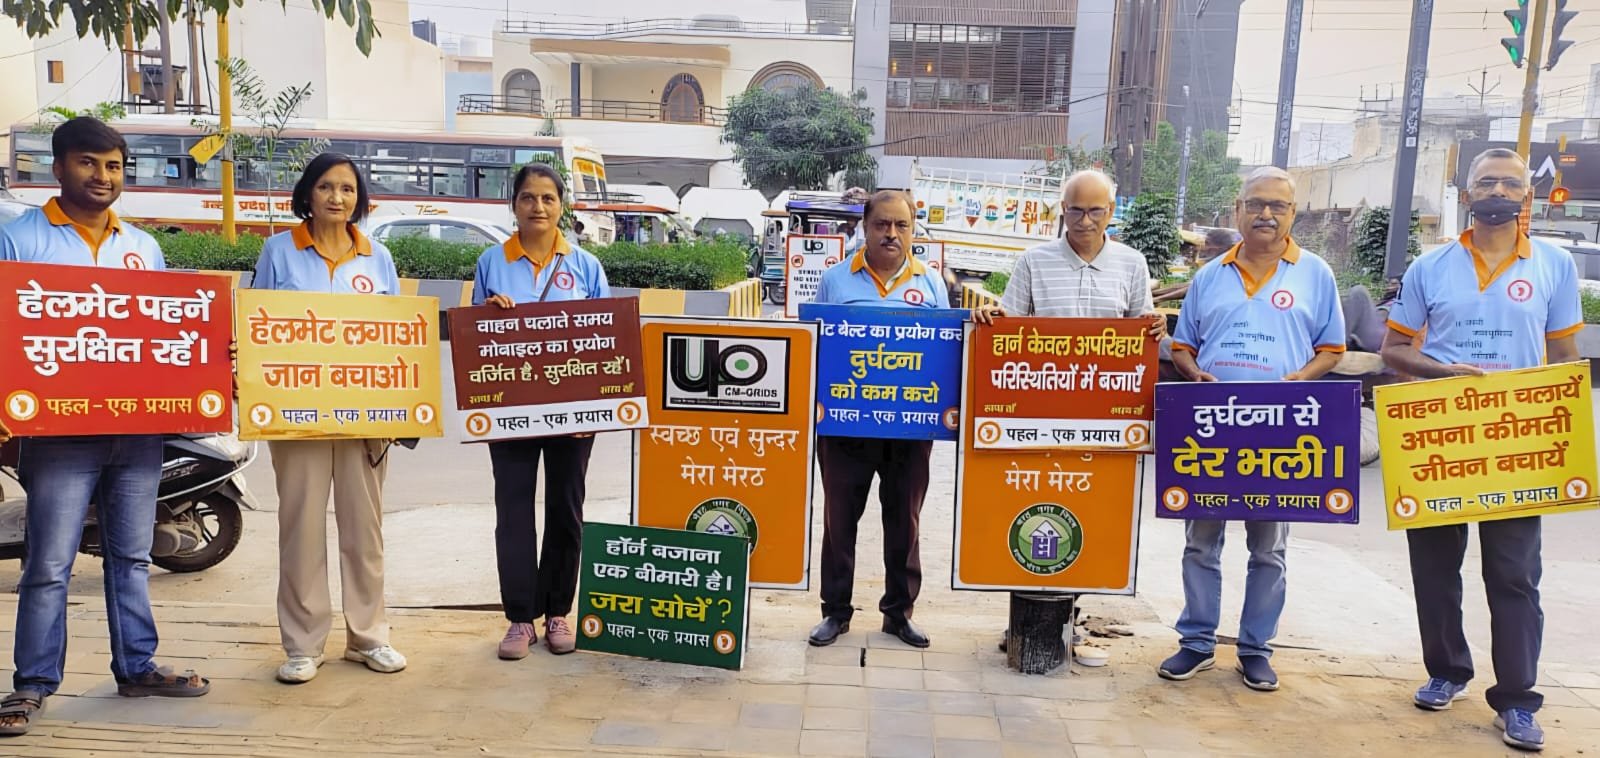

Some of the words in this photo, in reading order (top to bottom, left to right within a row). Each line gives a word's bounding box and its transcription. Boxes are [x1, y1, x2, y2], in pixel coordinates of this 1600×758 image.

[16, 279, 131, 319] हेलमेट
[136, 289, 216, 323] पहनें
[249, 306, 336, 345] हेलमेट
[341, 313, 428, 346] लगाओ
[476, 317, 520, 333] वाहन
[524, 311, 569, 330] चलाते
[573, 312, 613, 327] समय
[838, 320, 867, 337] बेल्ट
[870, 325, 892, 339] का
[894, 322, 935, 341] प्रयोग
[22, 326, 143, 376] सुरक्षित
[478, 339, 542, 358] मोबाइल
[545, 338, 568, 354] का
[572, 333, 616, 354] प्रयोग
[992, 326, 1025, 356] हार्न
[1027, 328, 1073, 356] केवल
[1074, 327, 1147, 357] अपरिहार्य
[468, 363, 516, 383] वर्जित
[543, 358, 598, 385] सुरक्षित
[850, 343, 923, 379] दुर्घटना
[262, 363, 322, 389] जान
[991, 361, 1079, 391] परिस्थितियों
[1080, 364, 1098, 391] में
[724, 387, 778, 398] CM-GRIDS
[830, 379, 857, 400] को
[861, 384, 898, 401] कम
[902, 381, 939, 403] करो
[1386, 397, 1447, 419] वाहन
[1454, 387, 1507, 411] धीमा
[1513, 374, 1584, 404] चलायें
[45, 398, 89, 416] पहल
[105, 398, 138, 417] एक
[143, 398, 192, 414] प्रयास
[281, 409, 318, 423] पहल
[333, 409, 360, 425] एक
[366, 409, 407, 423] प्रयास
[496, 417, 529, 430] पहल
[543, 413, 568, 429] एक
[573, 409, 613, 424] प्रयास
[828, 408, 860, 423] पहल
[872, 410, 896, 425] एक
[901, 411, 939, 425] प्रयास
[1193, 396, 1286, 437] दुर्घटना
[1293, 396, 1321, 426] से
[649, 425, 703, 446] स्वच्छ
[709, 419, 740, 452] एवं
[748, 428, 800, 457] सुन्दर
[1006, 428, 1038, 441] पहल
[1052, 429, 1076, 443] एक
[1082, 429, 1120, 443] प्रयास
[1401, 424, 1475, 450] अपना
[1482, 406, 1573, 440] कीमती
[1172, 435, 1229, 478] देर
[1409, 454, 1488, 481] जीवन
[1495, 441, 1569, 473] बचायें
[681, 456, 715, 486] मेरा
[723, 457, 766, 488] मेरठ
[1005, 462, 1040, 491] मेरा
[1048, 463, 1093, 492] मेरठ
[1193, 493, 1228, 507] पहल
[1243, 493, 1270, 509] एक
[1276, 494, 1320, 509] प्रयास
[1425, 497, 1462, 512] पहल
[1478, 492, 1506, 509] एक
[1513, 487, 1558, 503] प्रयास
[605, 536, 648, 556] हॉर्न
[652, 544, 721, 564] बजाना
[593, 562, 630, 579] एक
[635, 562, 700, 587] बीमारी
[588, 591, 643, 615] जरा
[607, 623, 635, 639] पहल
[648, 628, 669, 644] एक
[674, 631, 710, 648] प्रयास
